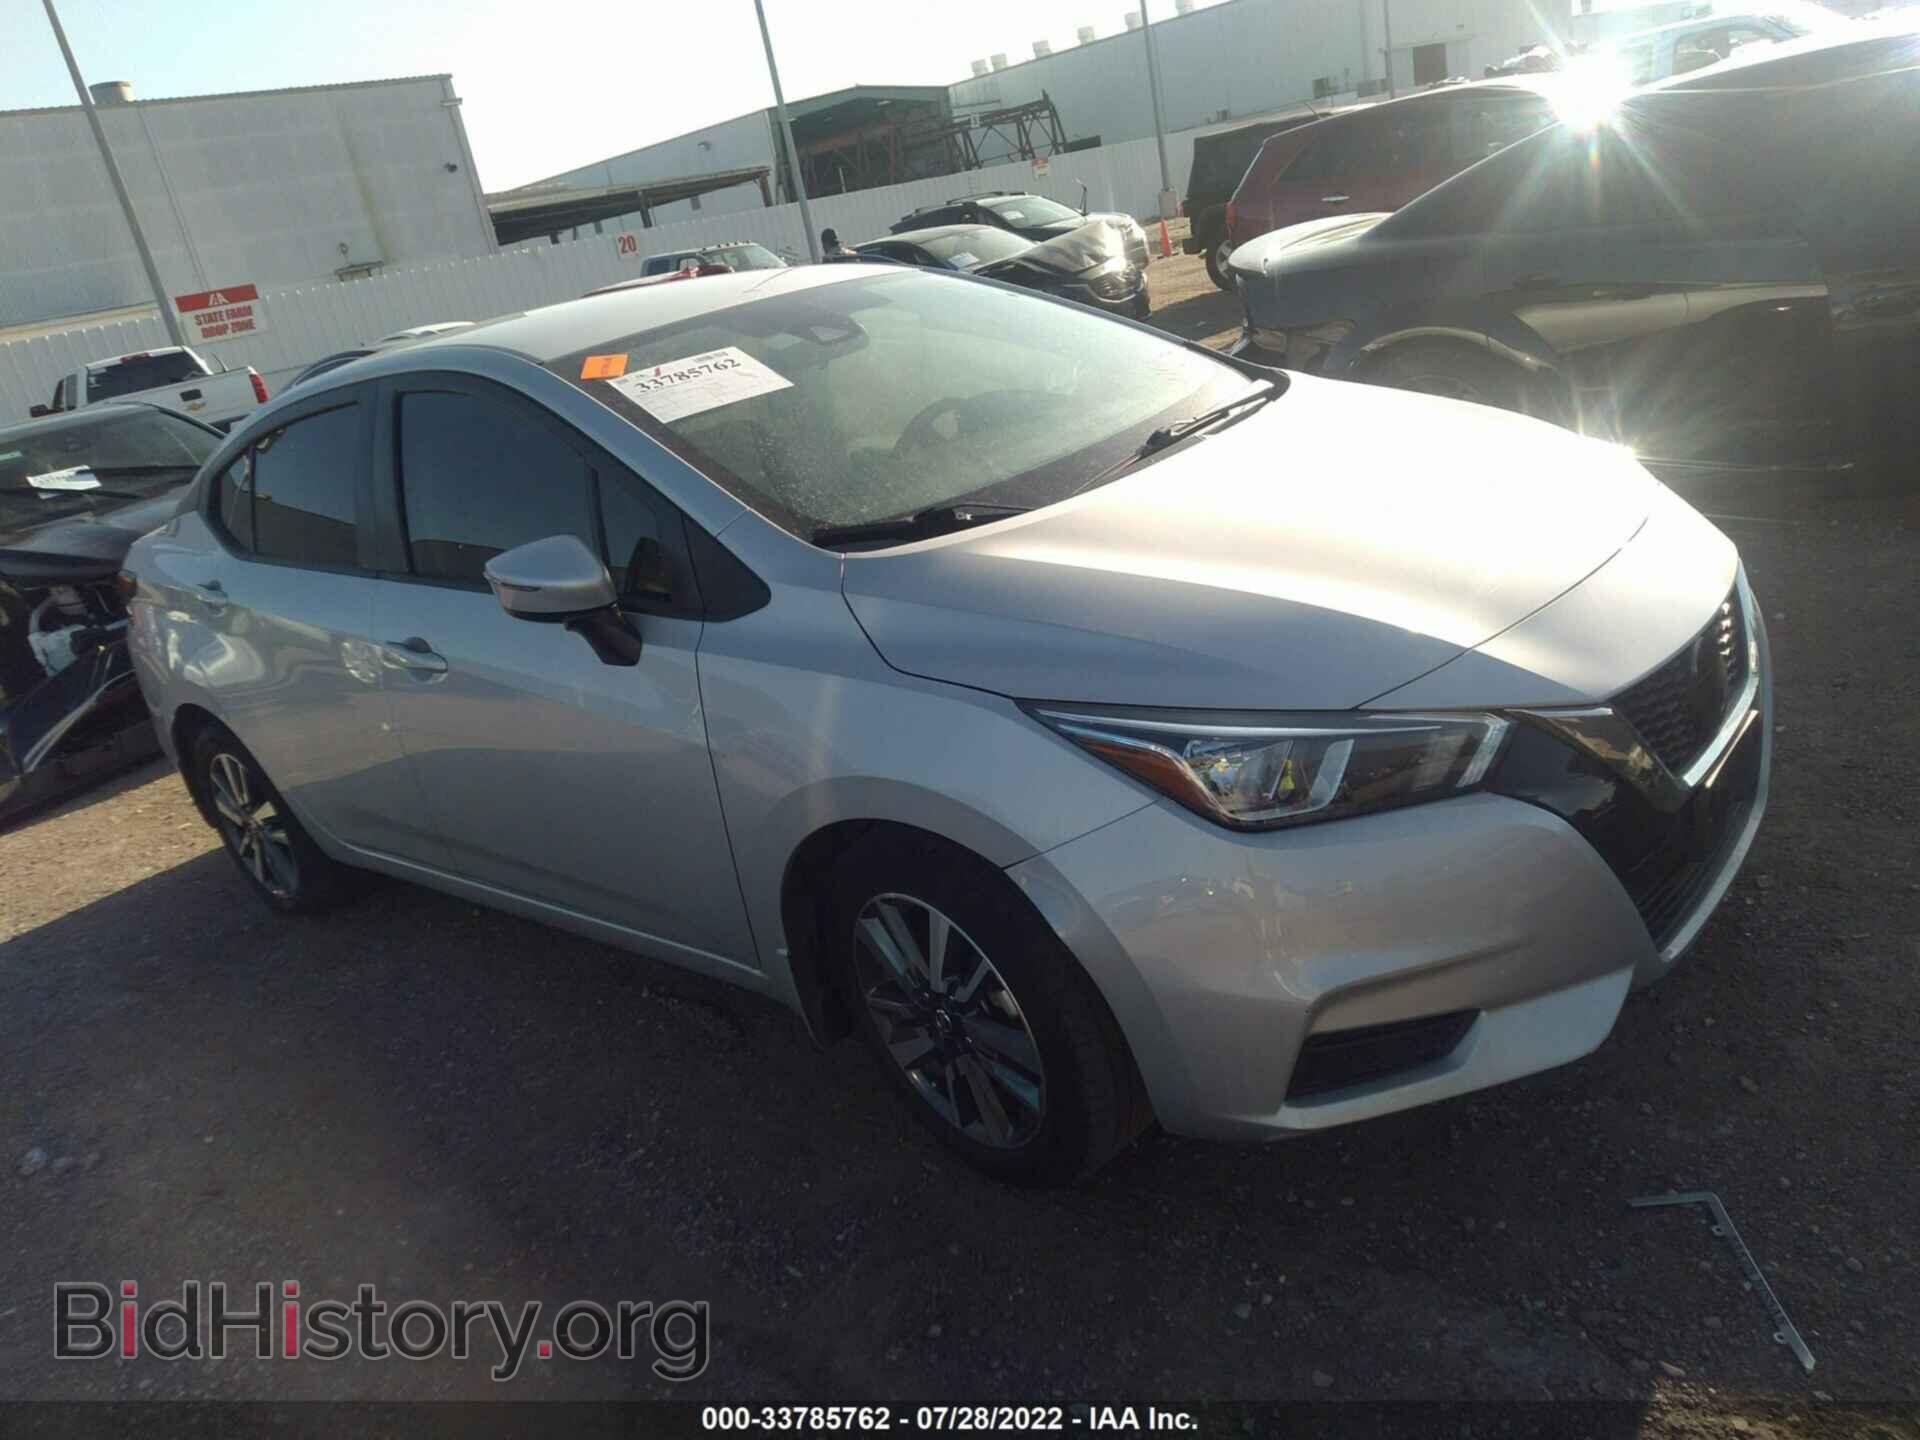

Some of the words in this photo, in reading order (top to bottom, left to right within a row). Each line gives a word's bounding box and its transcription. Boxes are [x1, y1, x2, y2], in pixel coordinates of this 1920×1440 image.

[617, 235, 637, 254] 20
[194, 311, 224, 326] STATE
[225, 305, 252, 319] FARM
[201, 324, 229, 338] DROP
[230, 318, 257, 332] ZONE
[634, 359, 742, 393] 33785762
